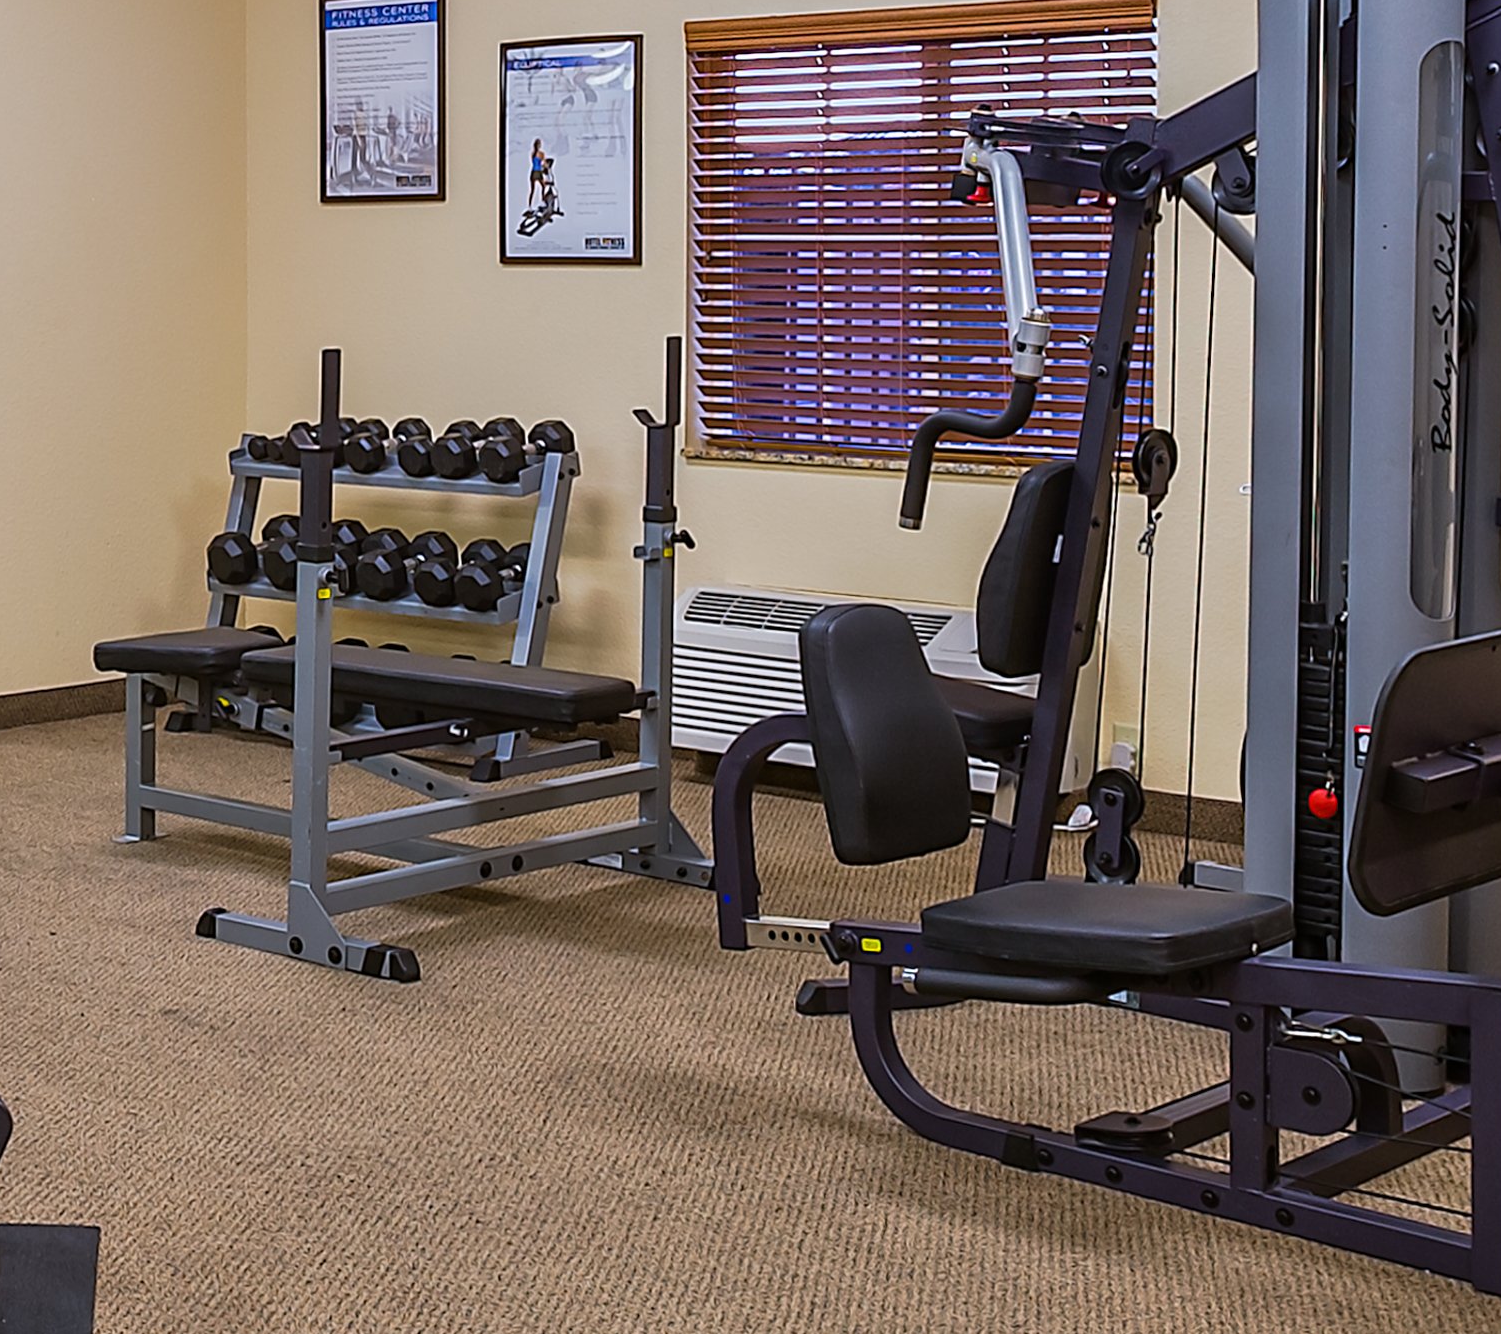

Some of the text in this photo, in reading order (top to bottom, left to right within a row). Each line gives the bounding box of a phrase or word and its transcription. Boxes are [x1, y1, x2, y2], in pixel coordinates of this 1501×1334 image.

[331, 4, 429, 19] FITNESS CENTER
[368, 13, 429, 25] REGULATIONS
[1431, 211, 1457, 454] Body-Solid
